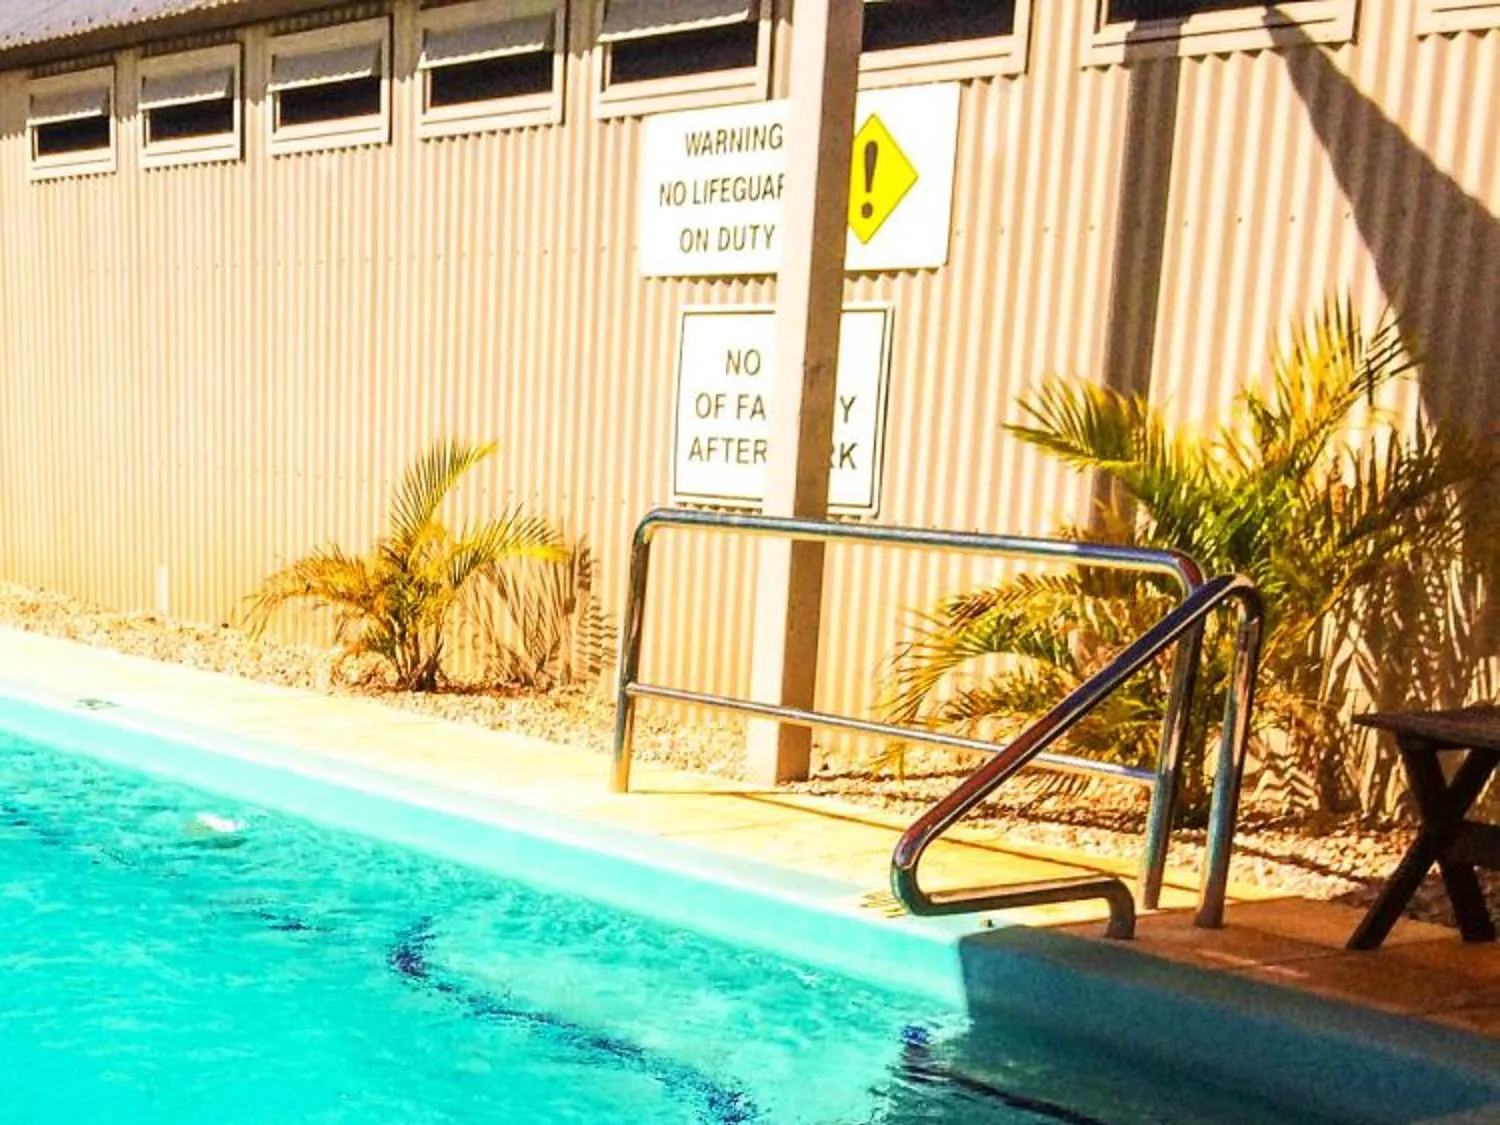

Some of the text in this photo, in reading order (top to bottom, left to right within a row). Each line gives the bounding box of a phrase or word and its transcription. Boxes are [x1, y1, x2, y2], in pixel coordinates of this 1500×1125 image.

[685, 122, 783, 157] WARNING
[659, 180, 687, 207] NO
[679, 223, 775, 253] ON DUTY
[725, 348, 761, 376] NO
[695, 392, 726, 419] OF
[688, 436, 768, 464] AFTER
